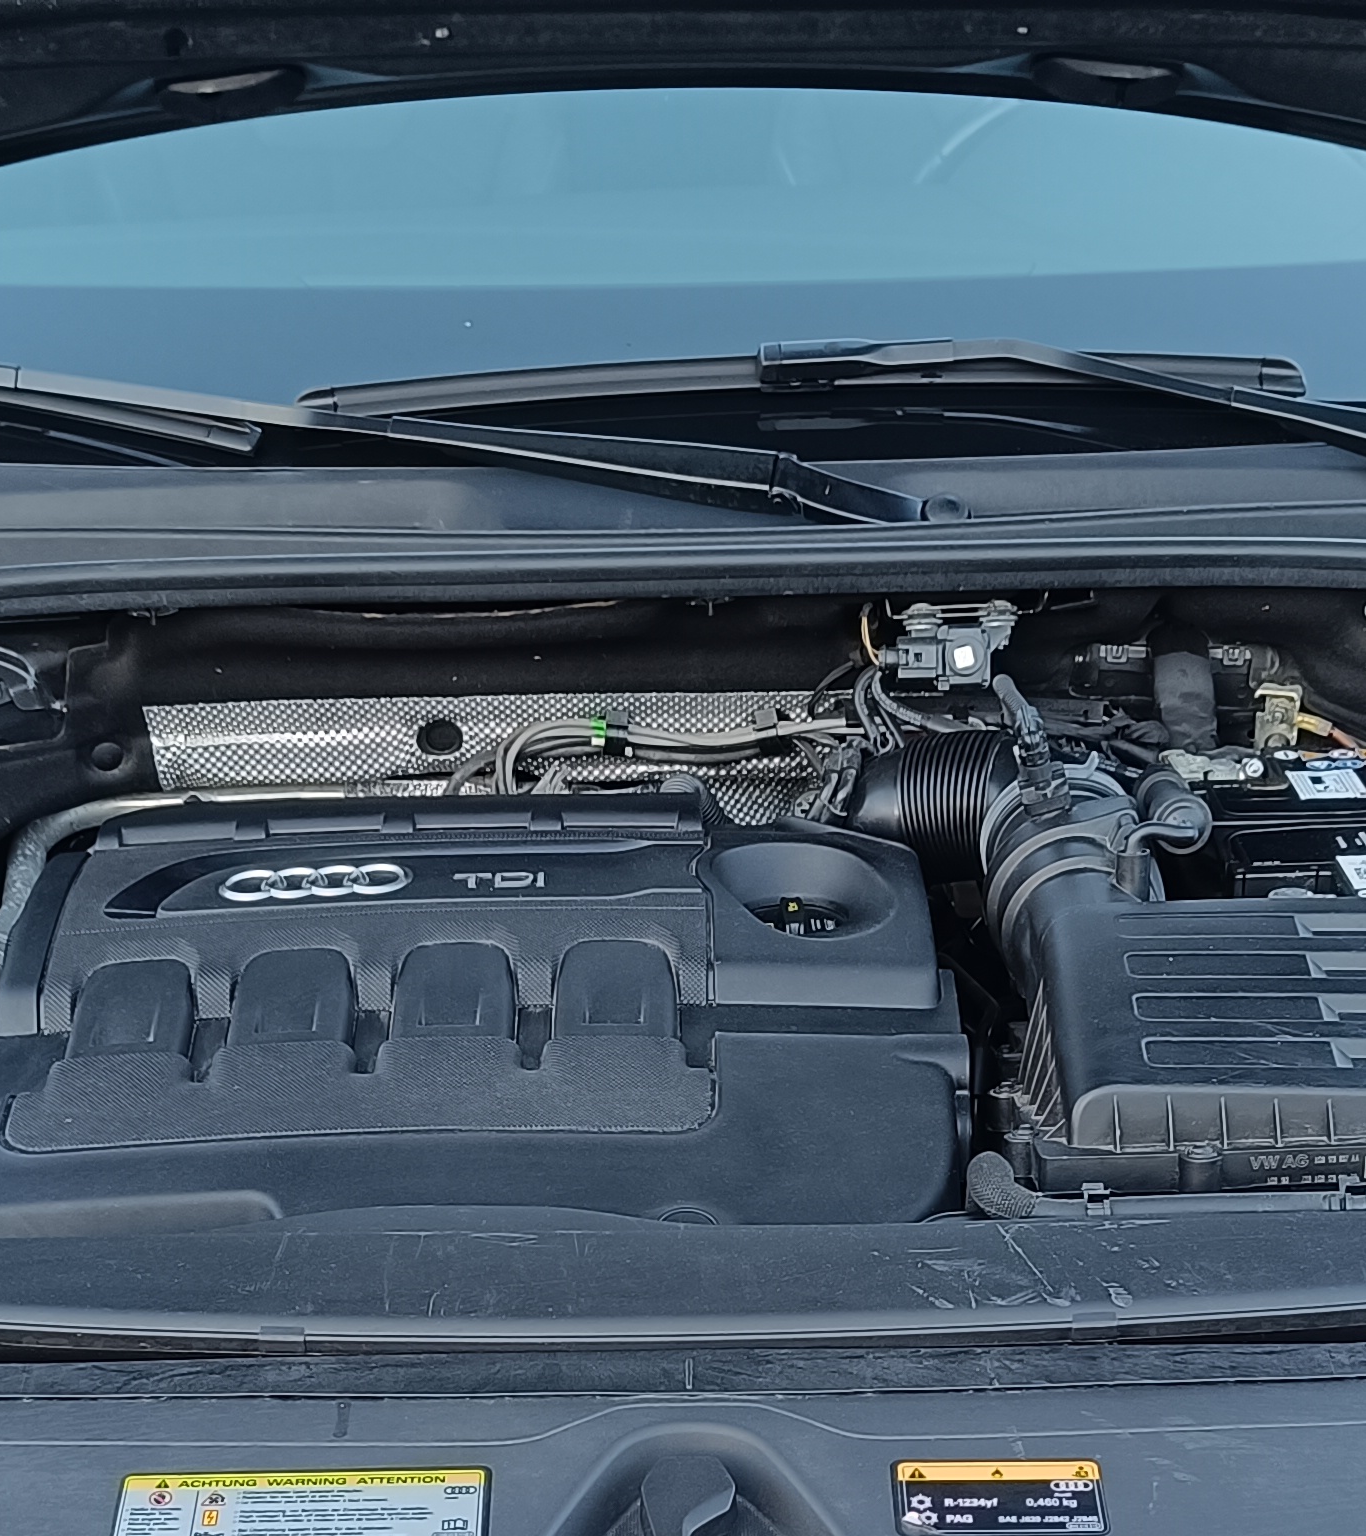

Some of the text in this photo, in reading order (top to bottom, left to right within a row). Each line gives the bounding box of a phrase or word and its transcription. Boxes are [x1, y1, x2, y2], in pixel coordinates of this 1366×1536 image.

[452, 871, 545, 889] TDI
[1249, 1154, 1281, 1170] VW
[1281, 1153, 1310, 1169] AG
[177, 1475, 447, 1489] ACHTUNG WARNING ATTENTION
[943, 1497, 999, 1509] R-1234yf
[1062, 1497, 1078, 1509] kg
[945, 1513, 974, 1524] PAG
